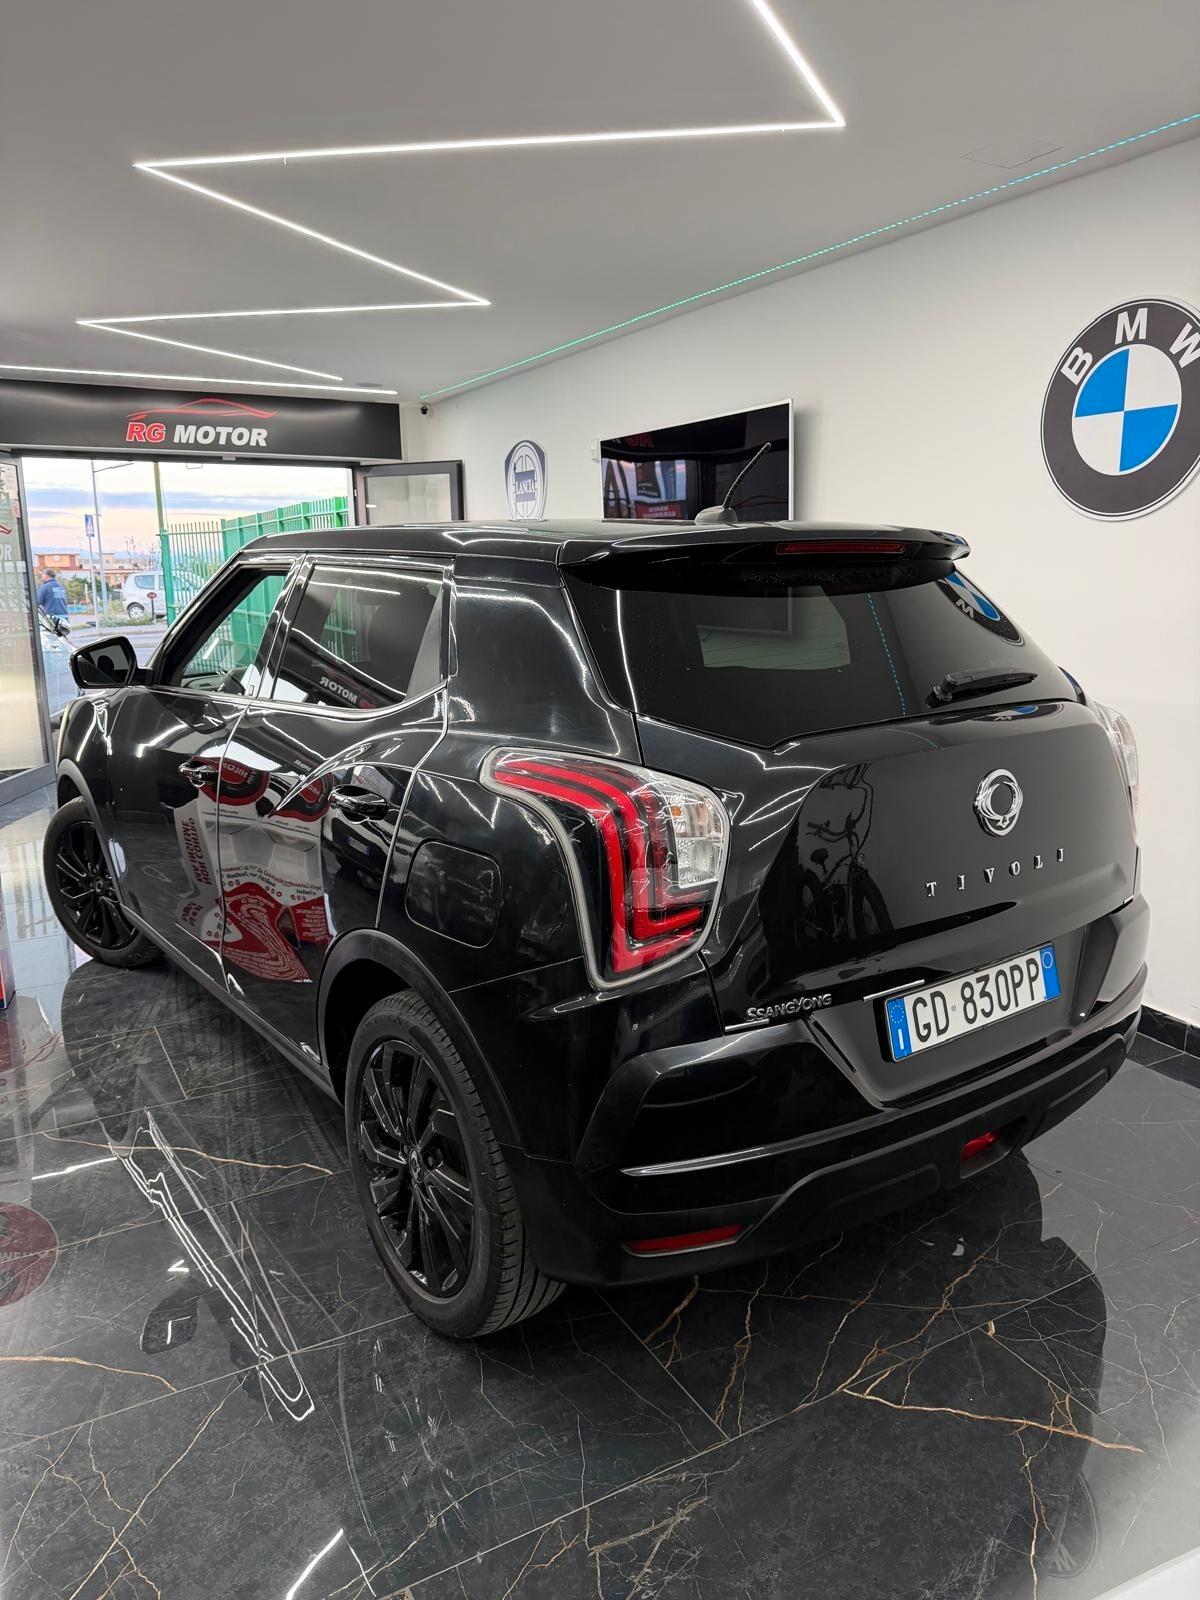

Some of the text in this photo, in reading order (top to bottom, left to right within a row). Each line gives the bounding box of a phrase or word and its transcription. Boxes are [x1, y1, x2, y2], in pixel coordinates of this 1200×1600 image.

[1060, 307, 1200, 386] BMW
[125, 421, 268, 447] RG MOTOR
[926, 847, 1064, 897] TIVOLI
[746, 993, 832, 1020] SSANGYONG
[912, 990, 950, 1042] GD
[960, 957, 1040, 1025] 830PP
